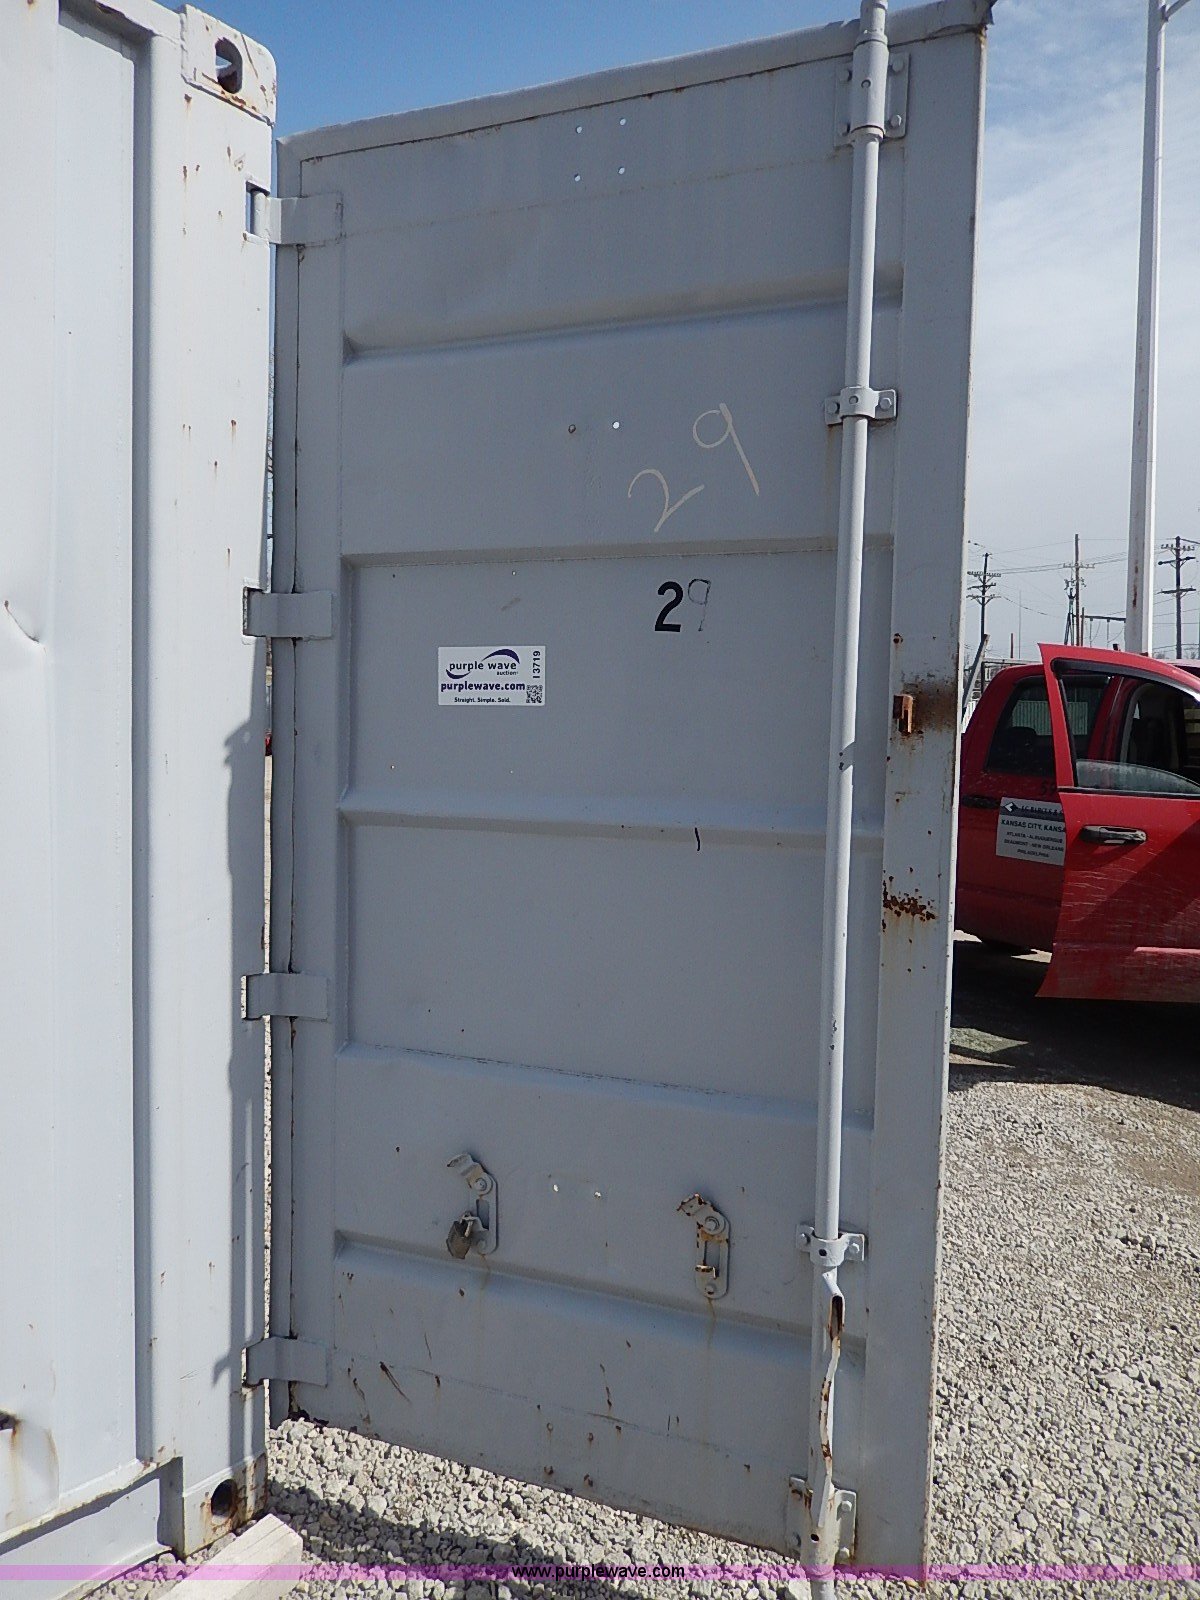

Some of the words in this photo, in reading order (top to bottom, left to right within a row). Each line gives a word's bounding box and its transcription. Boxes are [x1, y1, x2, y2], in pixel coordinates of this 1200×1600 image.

[628, 402, 760, 532] 29
[654, 578, 711, 632] 29
[449, 660, 484, 671] purple
[488, 662, 517, 670] wave
[532, 650, 541, 679] 13719
[440, 681, 525, 692] purplewave.com
[1001, 819, 1027, 828] KANSAS
